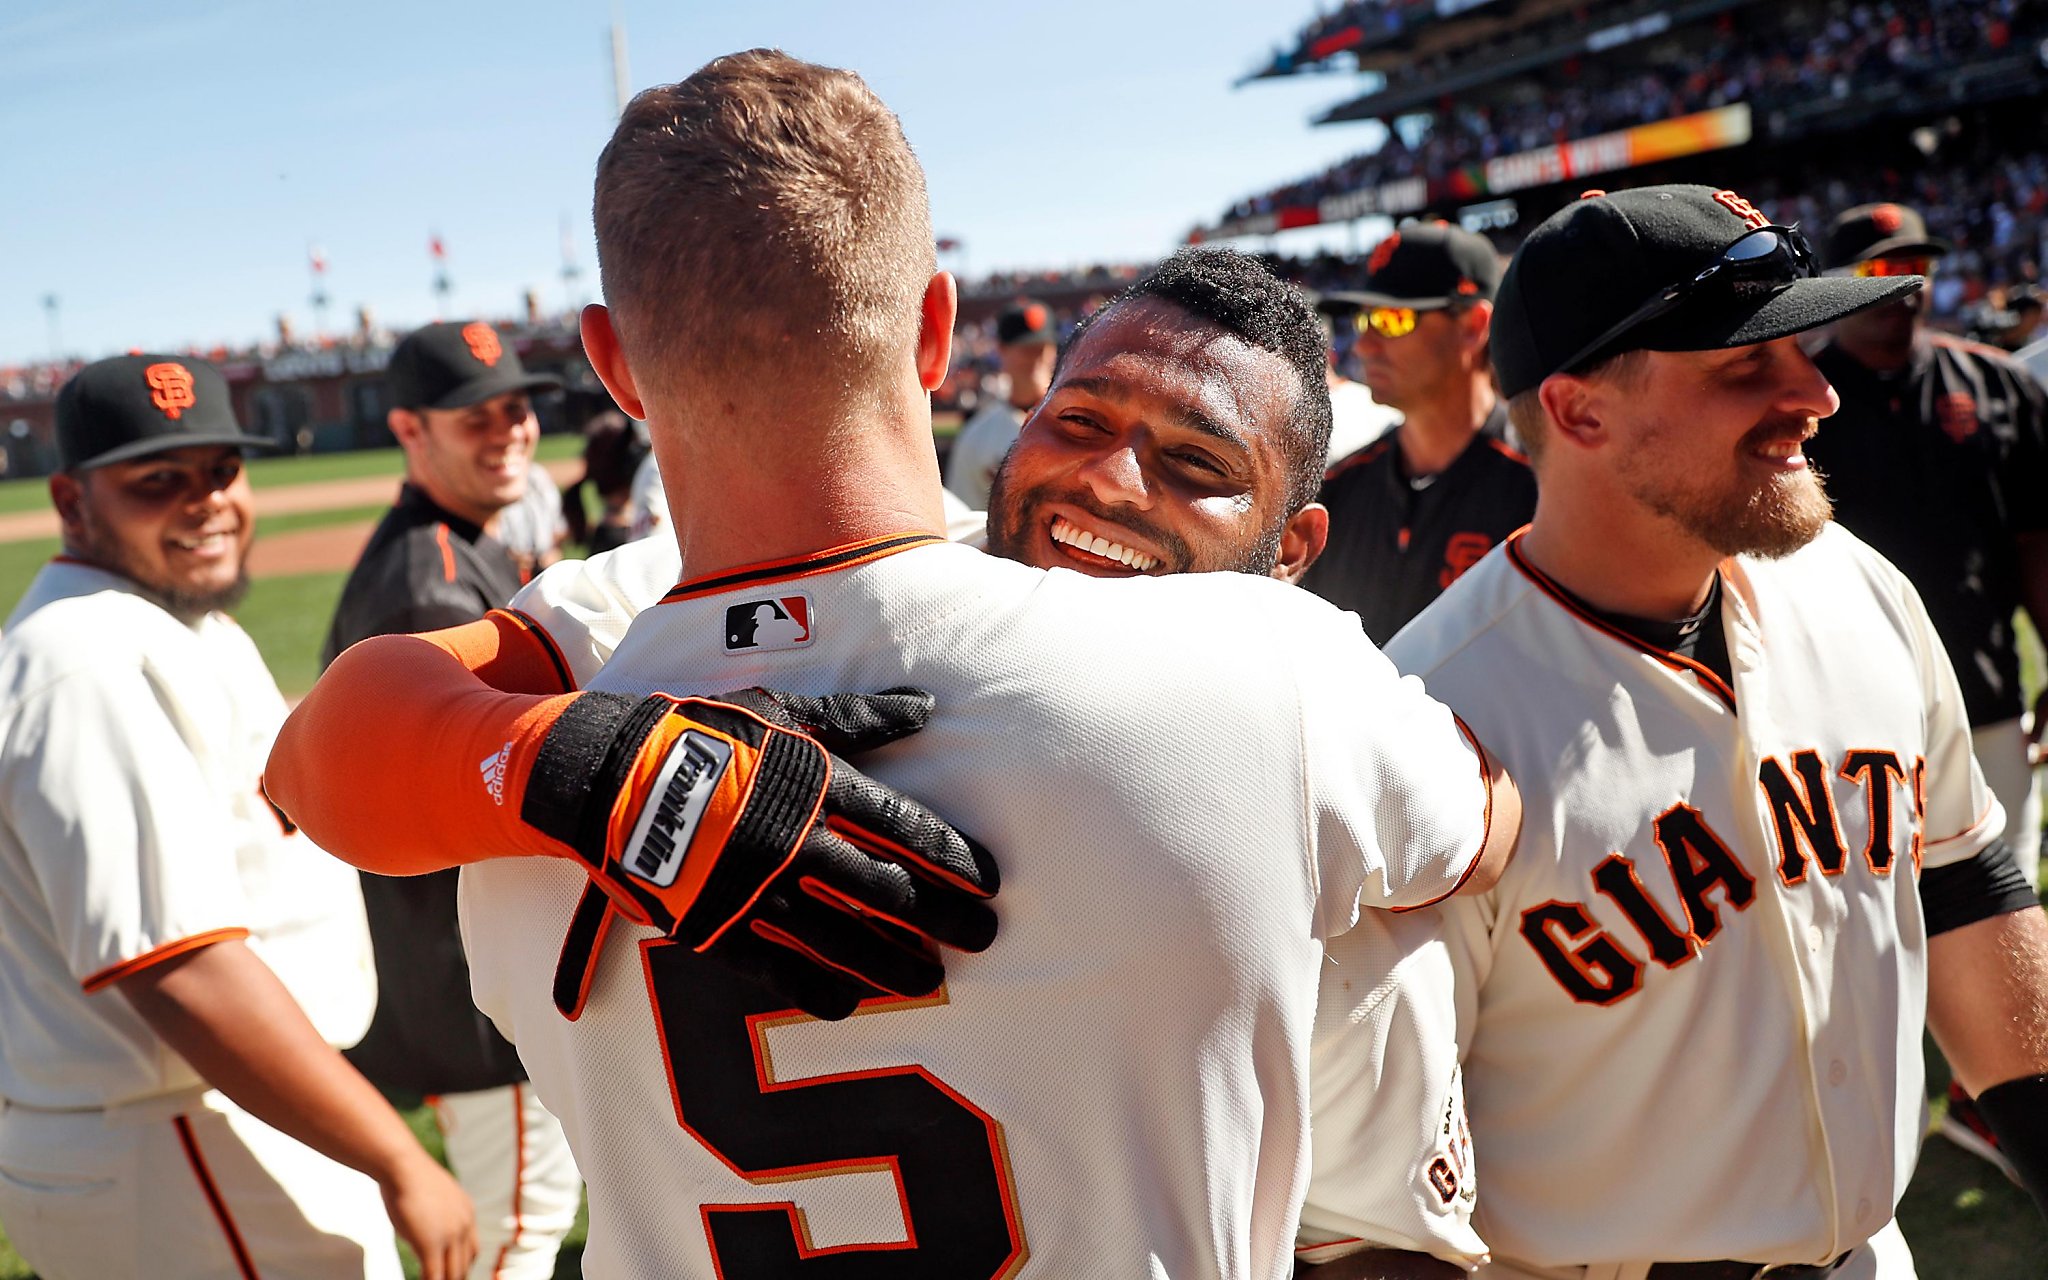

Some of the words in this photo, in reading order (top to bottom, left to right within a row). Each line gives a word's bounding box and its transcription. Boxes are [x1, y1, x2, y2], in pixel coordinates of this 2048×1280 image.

[493, 741, 513, 806] adidas
[635, 734, 720, 879] Franklin
[639, 937, 1030, 1280] 5
